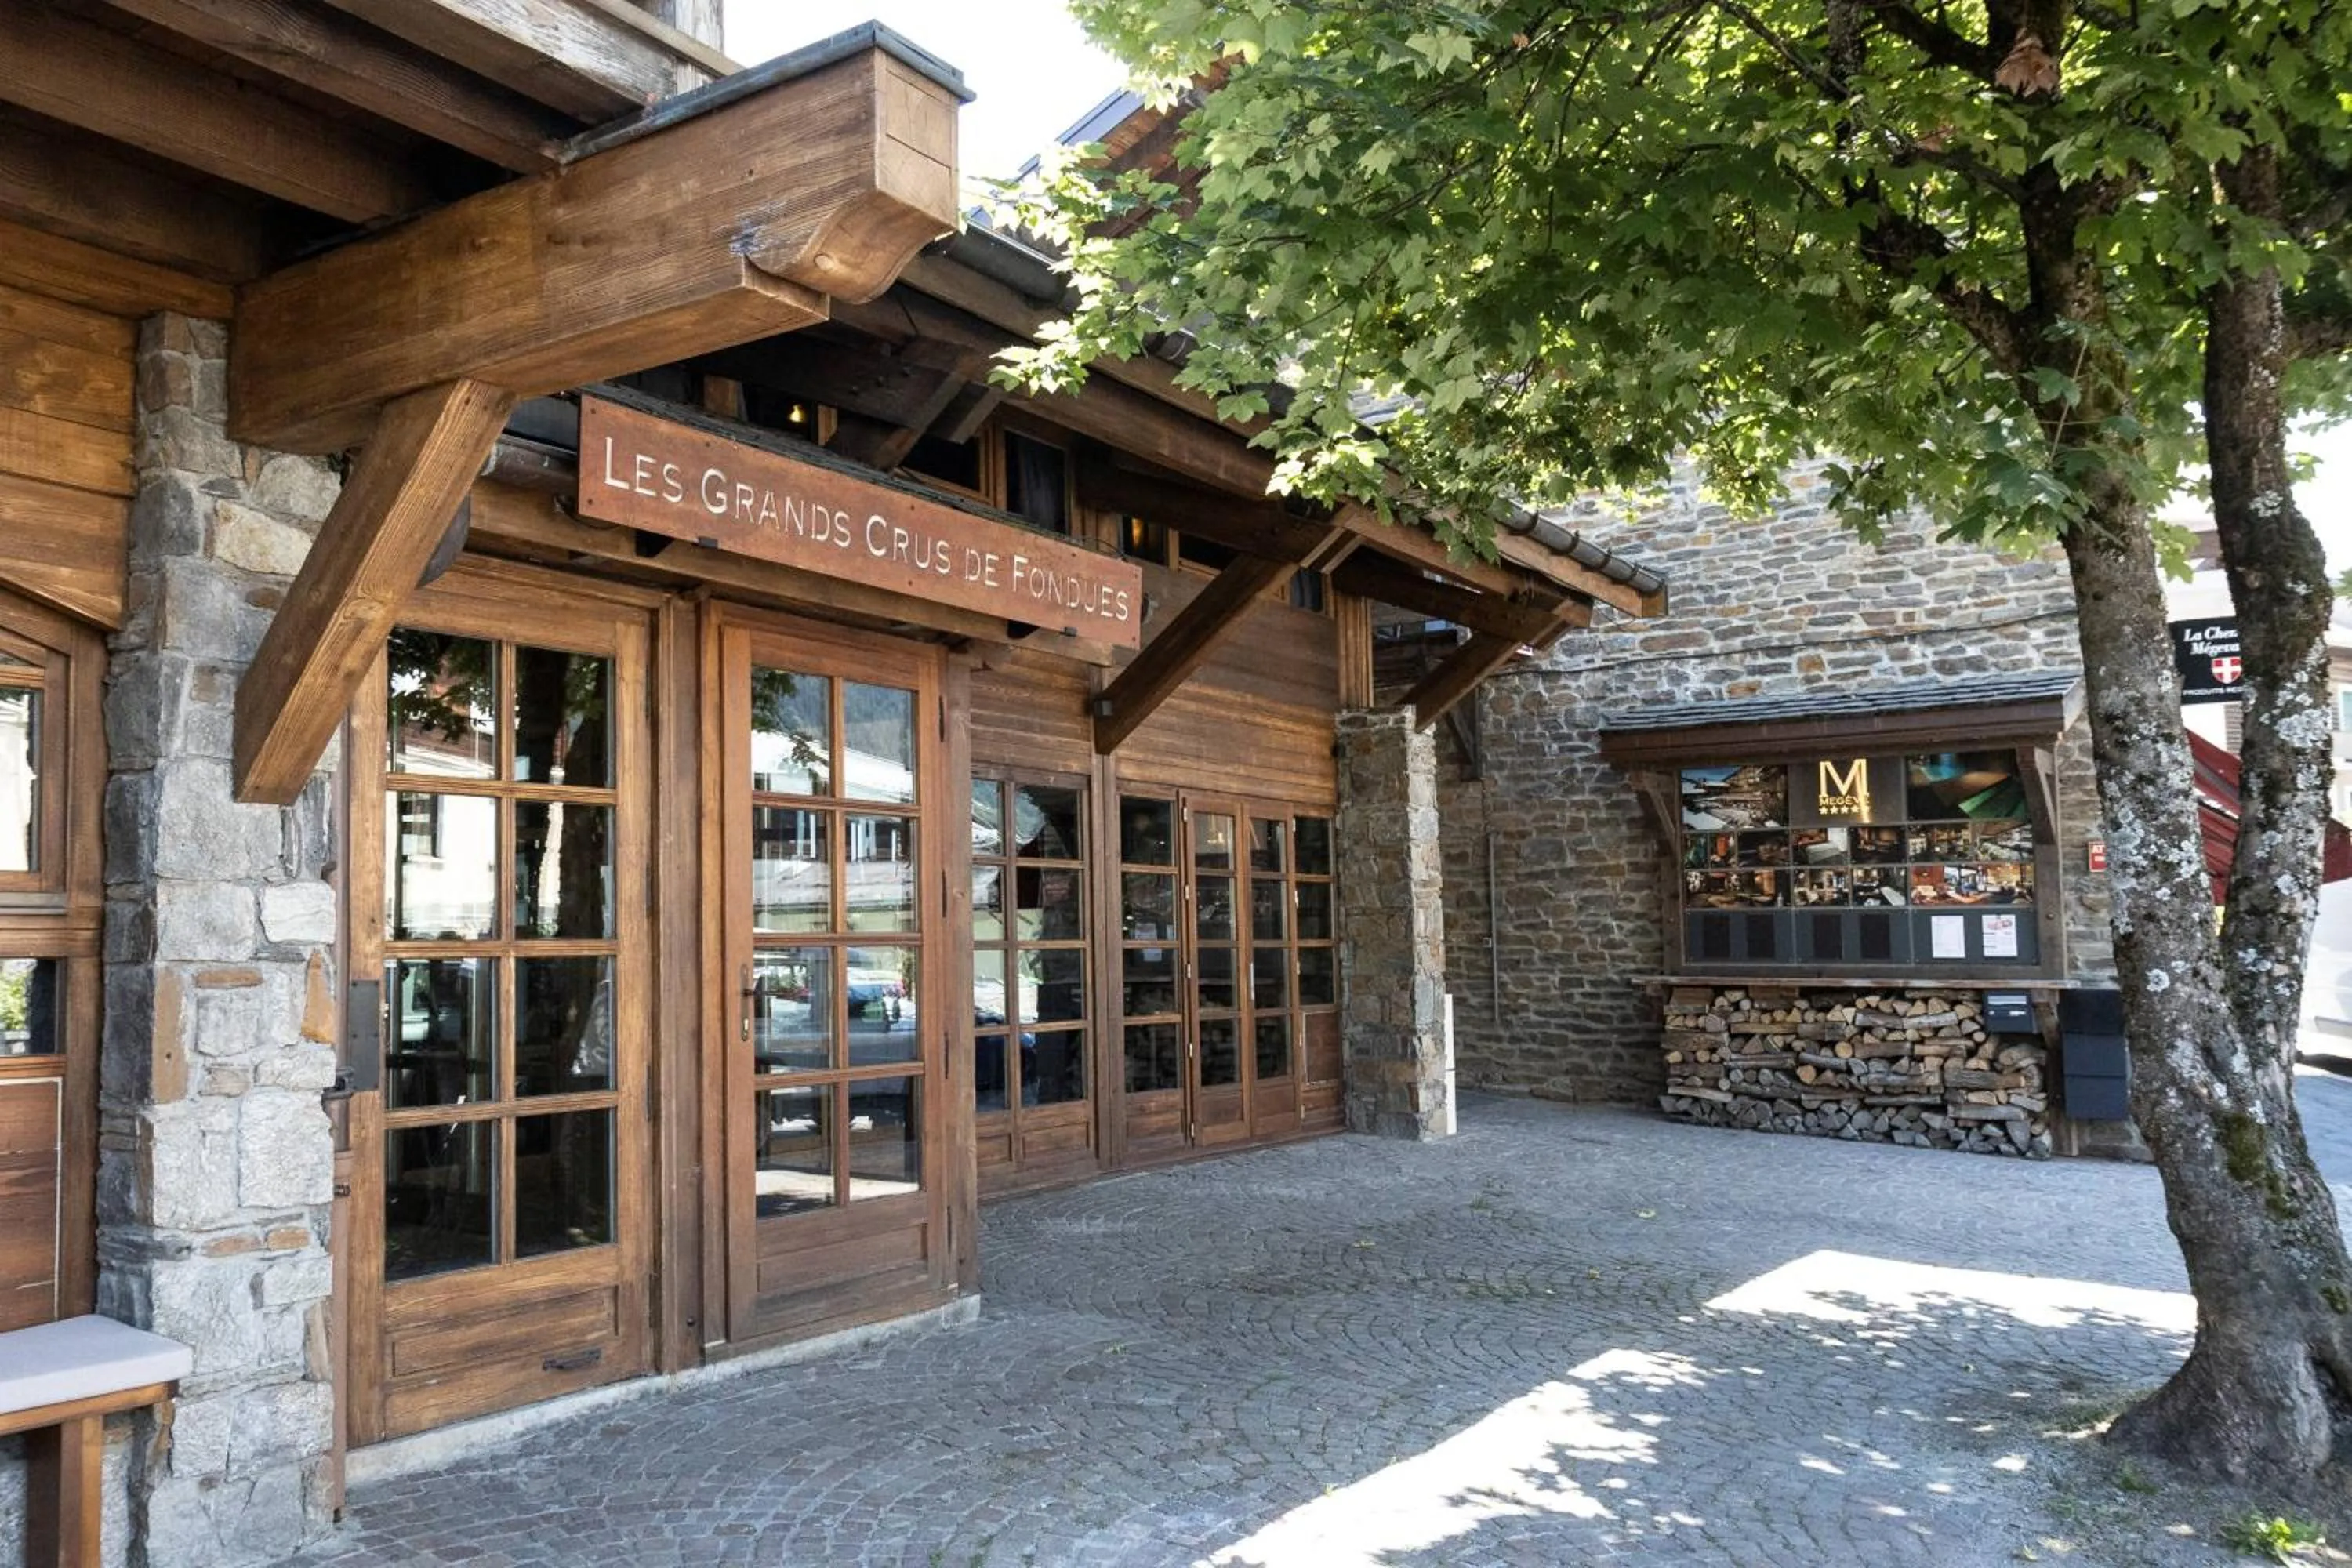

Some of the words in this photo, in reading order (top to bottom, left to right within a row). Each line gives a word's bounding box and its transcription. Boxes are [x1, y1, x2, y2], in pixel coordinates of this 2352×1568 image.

[604, 436, 684, 503] LES
[701, 467, 851, 548] GRANDS
[865, 514, 951, 575] CRUS
[964, 547, 1000, 587] DE
[1819, 758, 1869, 797] M
